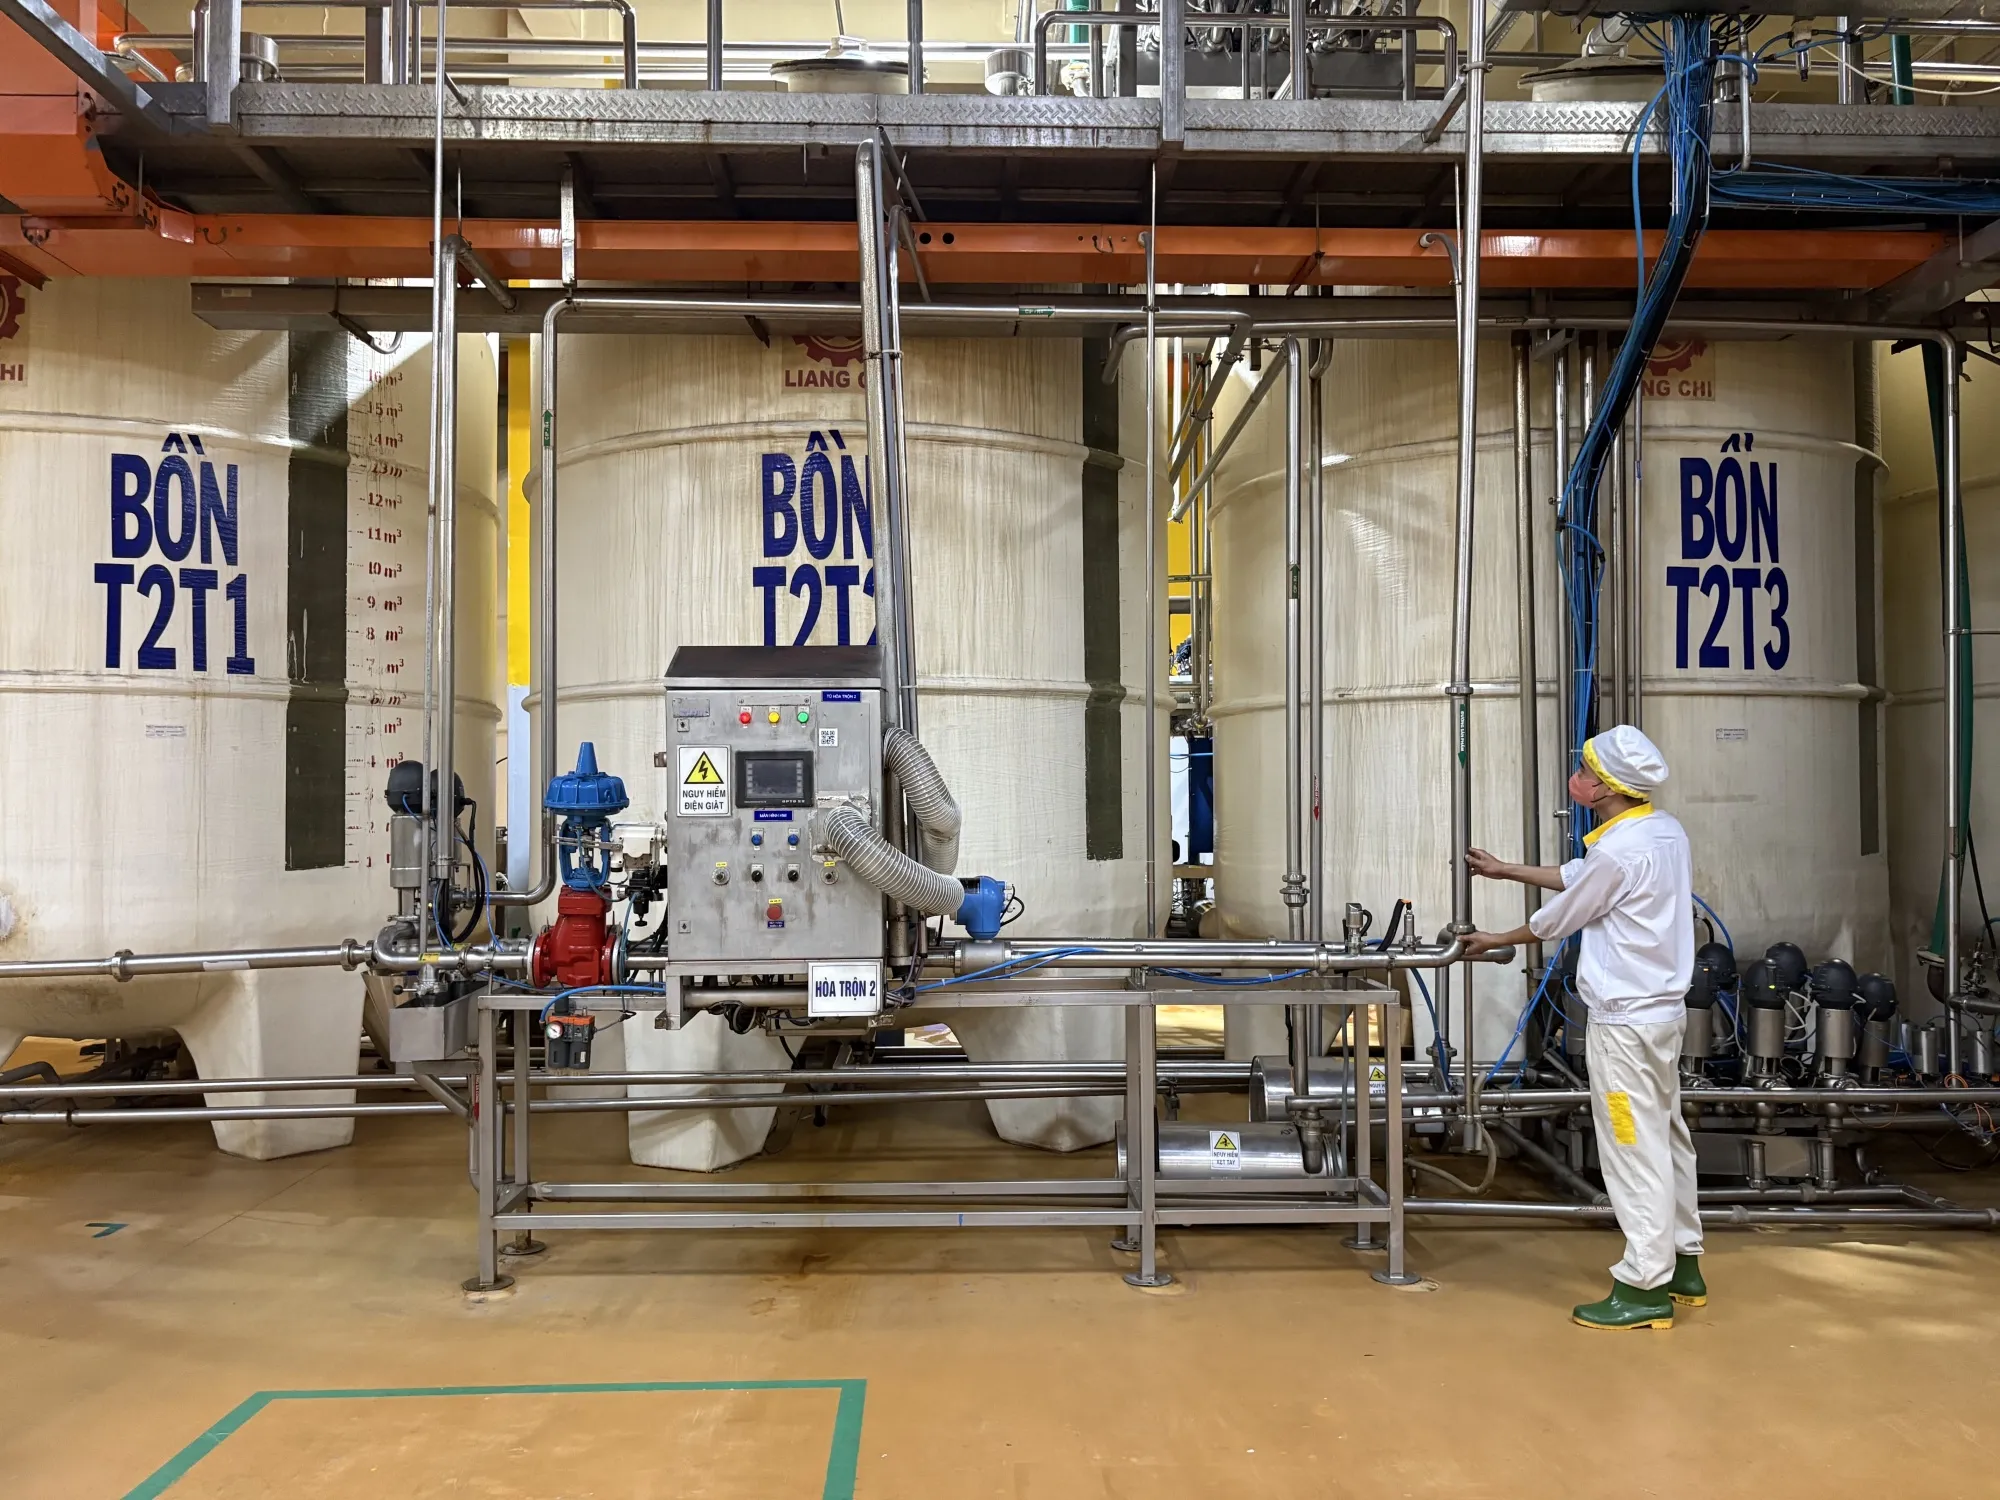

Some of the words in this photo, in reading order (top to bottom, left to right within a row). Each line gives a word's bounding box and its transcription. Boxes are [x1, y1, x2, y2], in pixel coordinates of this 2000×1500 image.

[0, 363, 24, 381] HI
[785, 369, 851, 388] LIANG
[1678, 379, 1713, 397] CHI
[111, 433, 239, 567] BỒN
[368, 492, 384, 508] 12
[762, 430, 873, 560] BỒN
[753, 563, 876, 647] T2T
[94, 562, 256, 675] T2T1
[1666, 564, 1790, 671] T2T3
[682, 789, 705, 798] NGUY
[706, 787, 726, 798] HIỂM
[684, 800, 704, 811] ĐIỆN
[705, 800, 724, 811] GIẬT
[815, 977, 836, 997] HÒA
[839, 976, 867, 1001] TRỘN
[869, 980, 876, 997] 2
